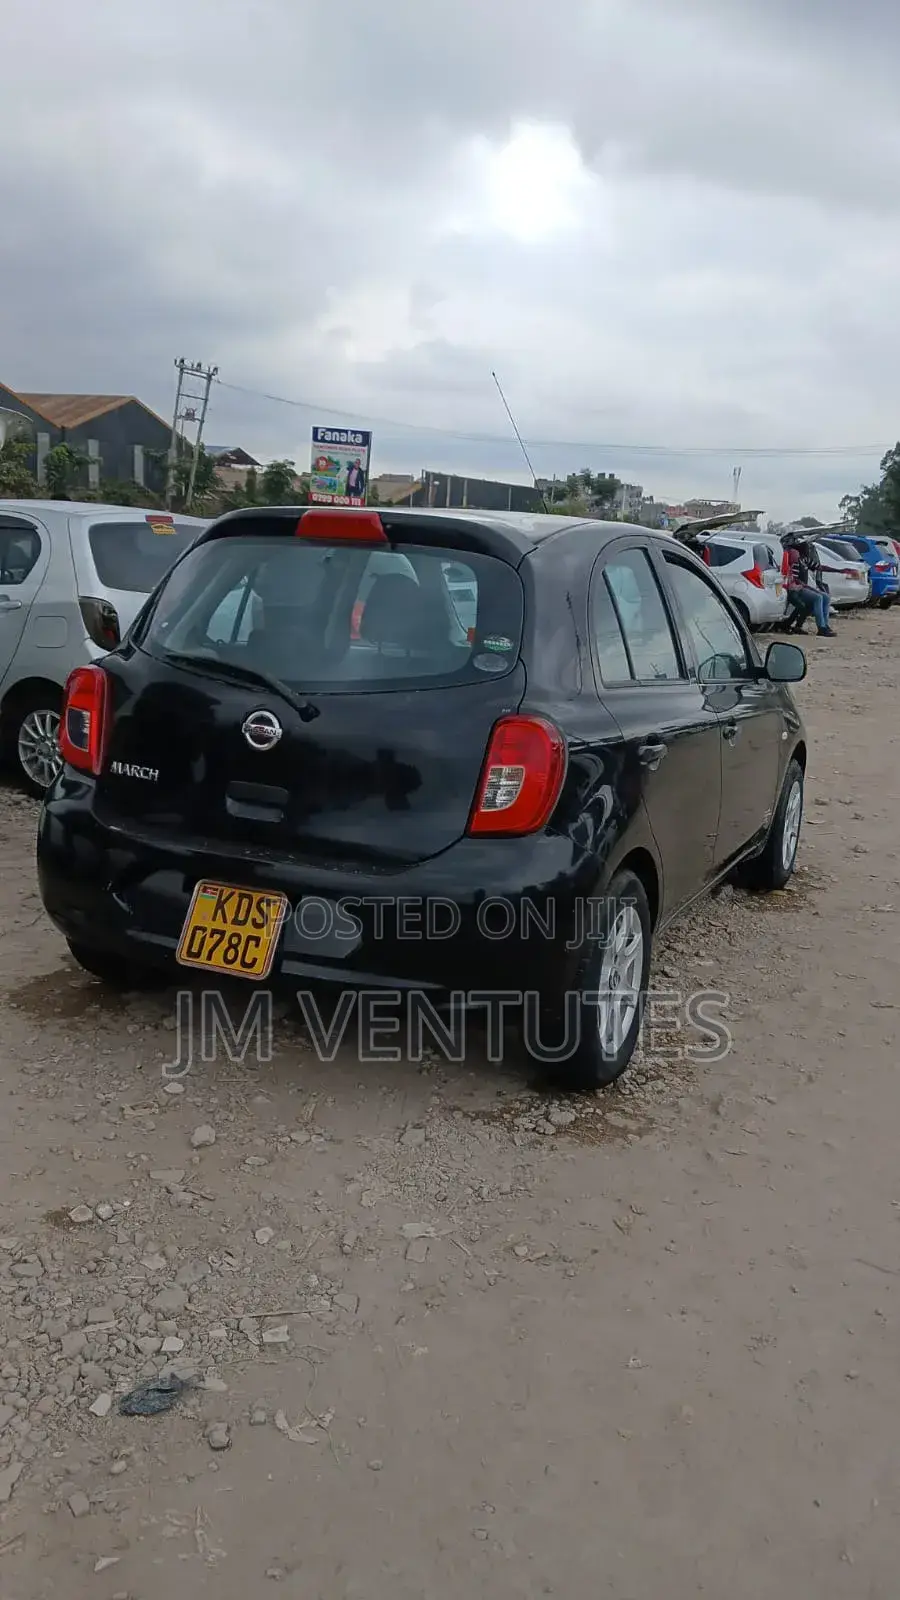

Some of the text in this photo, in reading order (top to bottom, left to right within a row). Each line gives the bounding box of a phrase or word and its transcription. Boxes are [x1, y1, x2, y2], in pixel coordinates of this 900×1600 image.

[317, 428, 363, 444] Fanaka
[110, 760, 160, 782] MARCH
[211, 888, 271, 930] KDS
[186, 924, 262, 969] 078C
